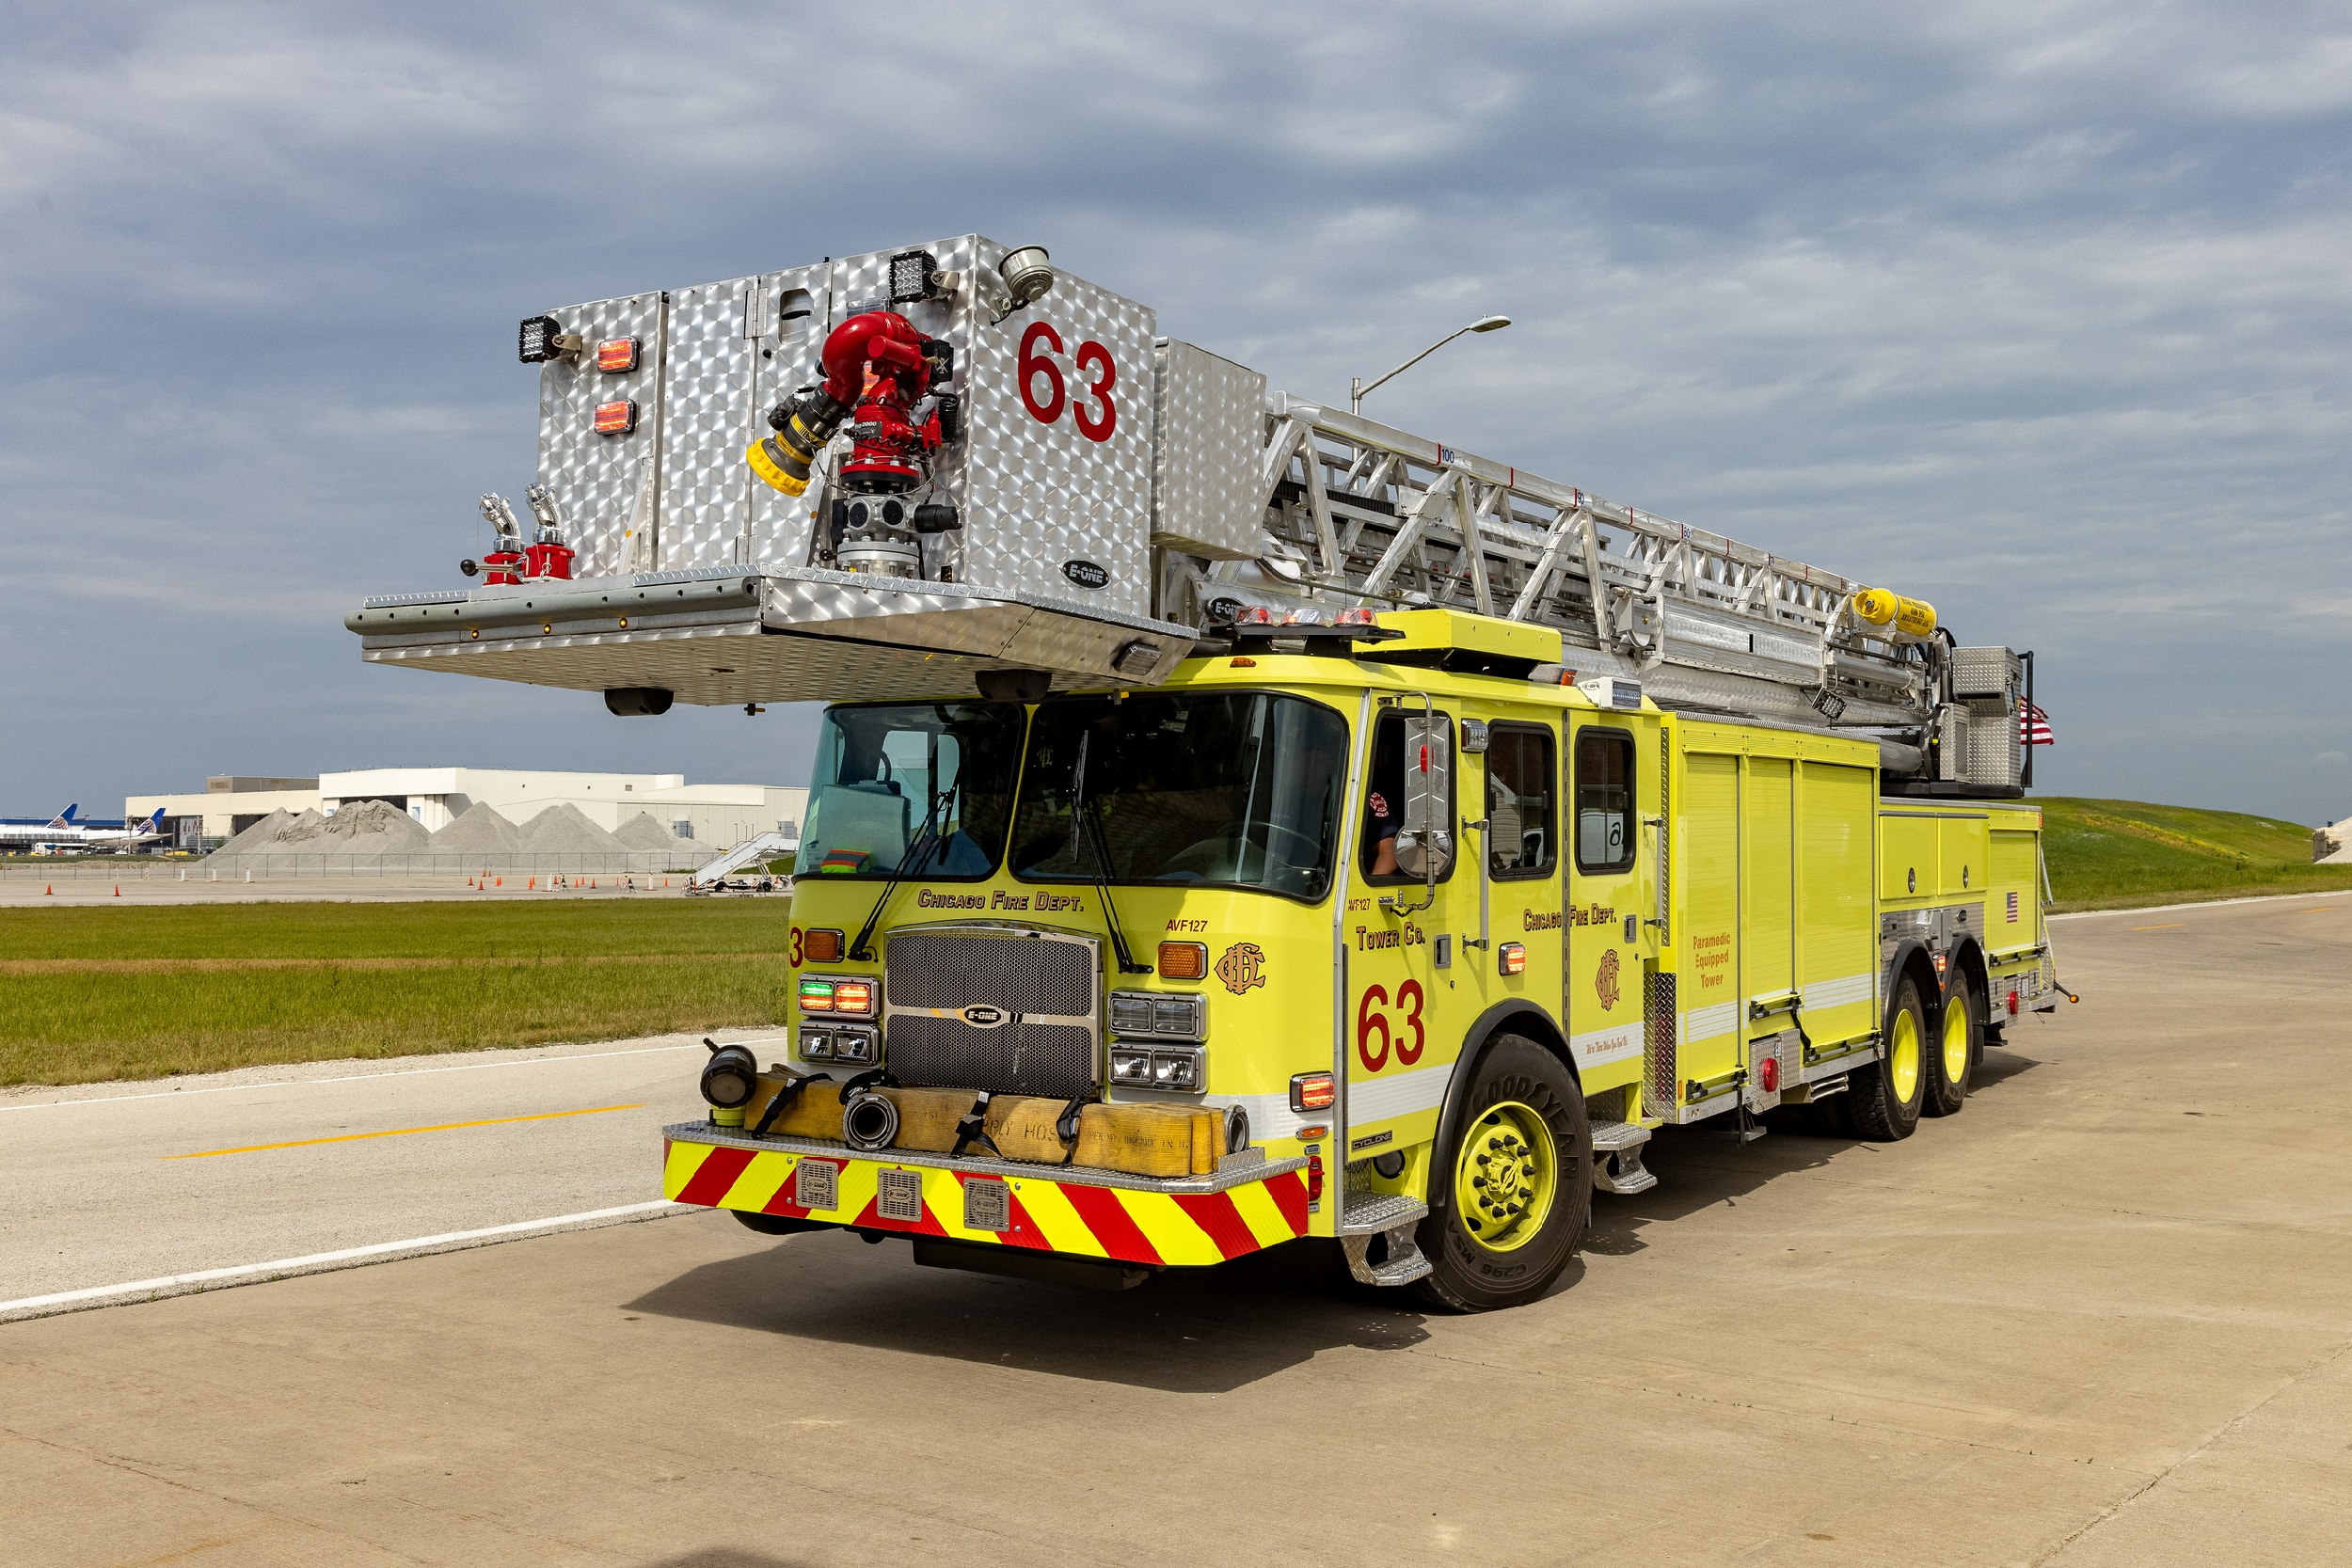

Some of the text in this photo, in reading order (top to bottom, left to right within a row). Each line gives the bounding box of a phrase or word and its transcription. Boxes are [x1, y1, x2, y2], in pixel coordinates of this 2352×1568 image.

[1018, 321, 1117, 442] 63
[1441, 448, 1454, 464] 100
[1577, 491, 1585, 505] 90
[1069, 563, 1104, 584] E-ONE
[1215, 601, 1238, 616] E-ON
[918, 889, 1084, 911] CHICAGO FIRE DEPT.
[1348, 897, 1371, 912] AVF127
[1166, 919, 1209, 933] AVF127
[1523, 903, 1617, 932] CHICAGO FIRE DEPT.
[1356, 921, 1425, 951] TOWER CO.
[1692, 931, 1731, 950] Paramedic
[1695, 948, 1729, 971] Equipped
[1700, 974, 1724, 989] Tower
[967, 1010, 998, 1021] E-ONE
[1357, 983, 1425, 1073] 63
[1024, 1119, 1058, 1142] HOS
[1353, 1132, 1392, 1149] CYCLONE
